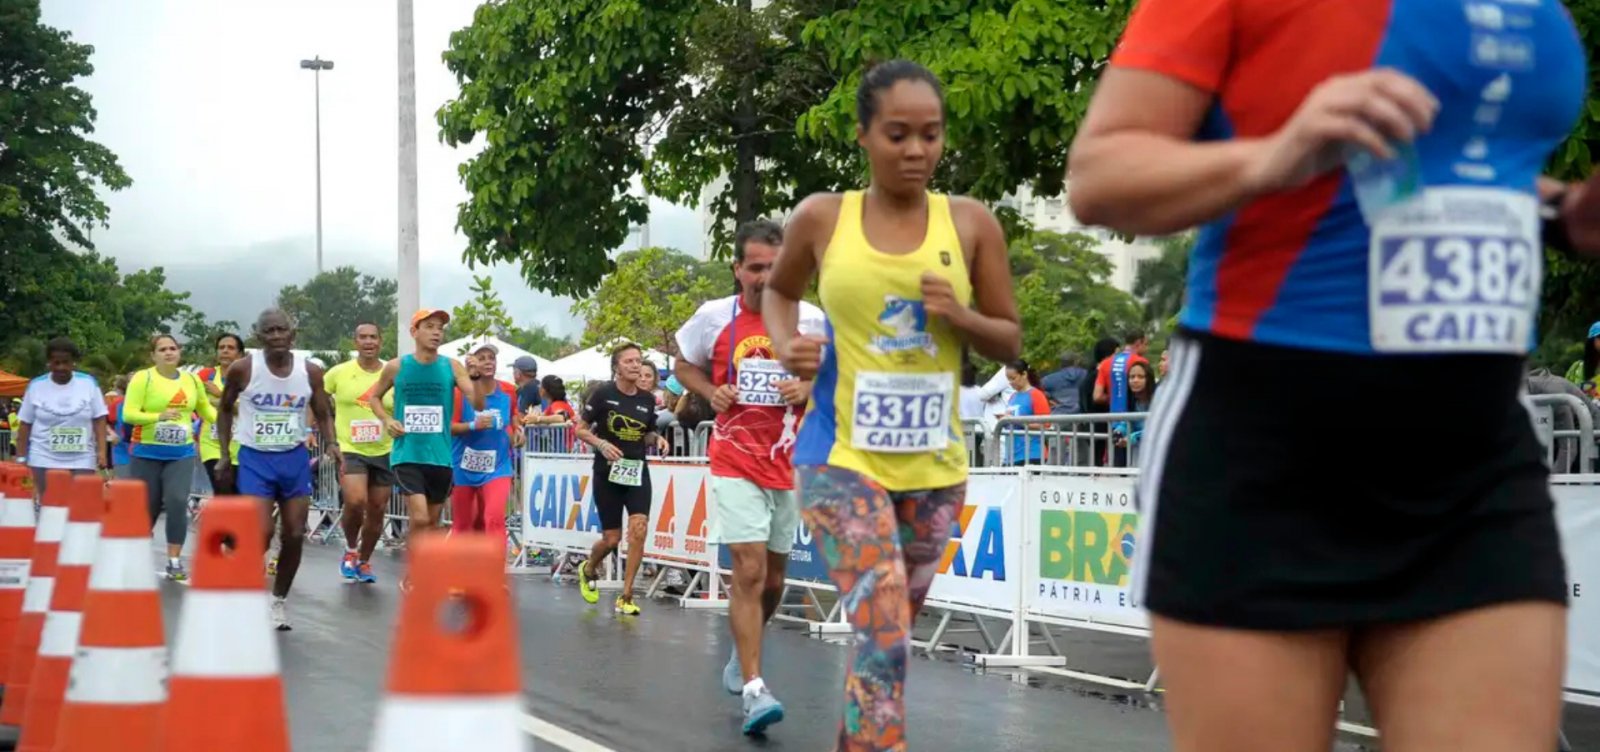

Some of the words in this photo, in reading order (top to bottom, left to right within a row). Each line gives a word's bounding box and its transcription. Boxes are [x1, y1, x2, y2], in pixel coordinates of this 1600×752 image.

[1381, 238, 1532, 303] 4382
[251, 393, 306, 408] CAIXA
[857, 393, 941, 428] 3316
[405, 413, 439, 425] 4260
[52, 434, 82, 444] 2787
[866, 431, 929, 447] CAIXA
[613, 465, 639, 477] 2745
[1040, 490, 1129, 507] GOVERNO
[1039, 509, 1138, 586] BRA
[1039, 582, 1102, 604] PÁTRIA
